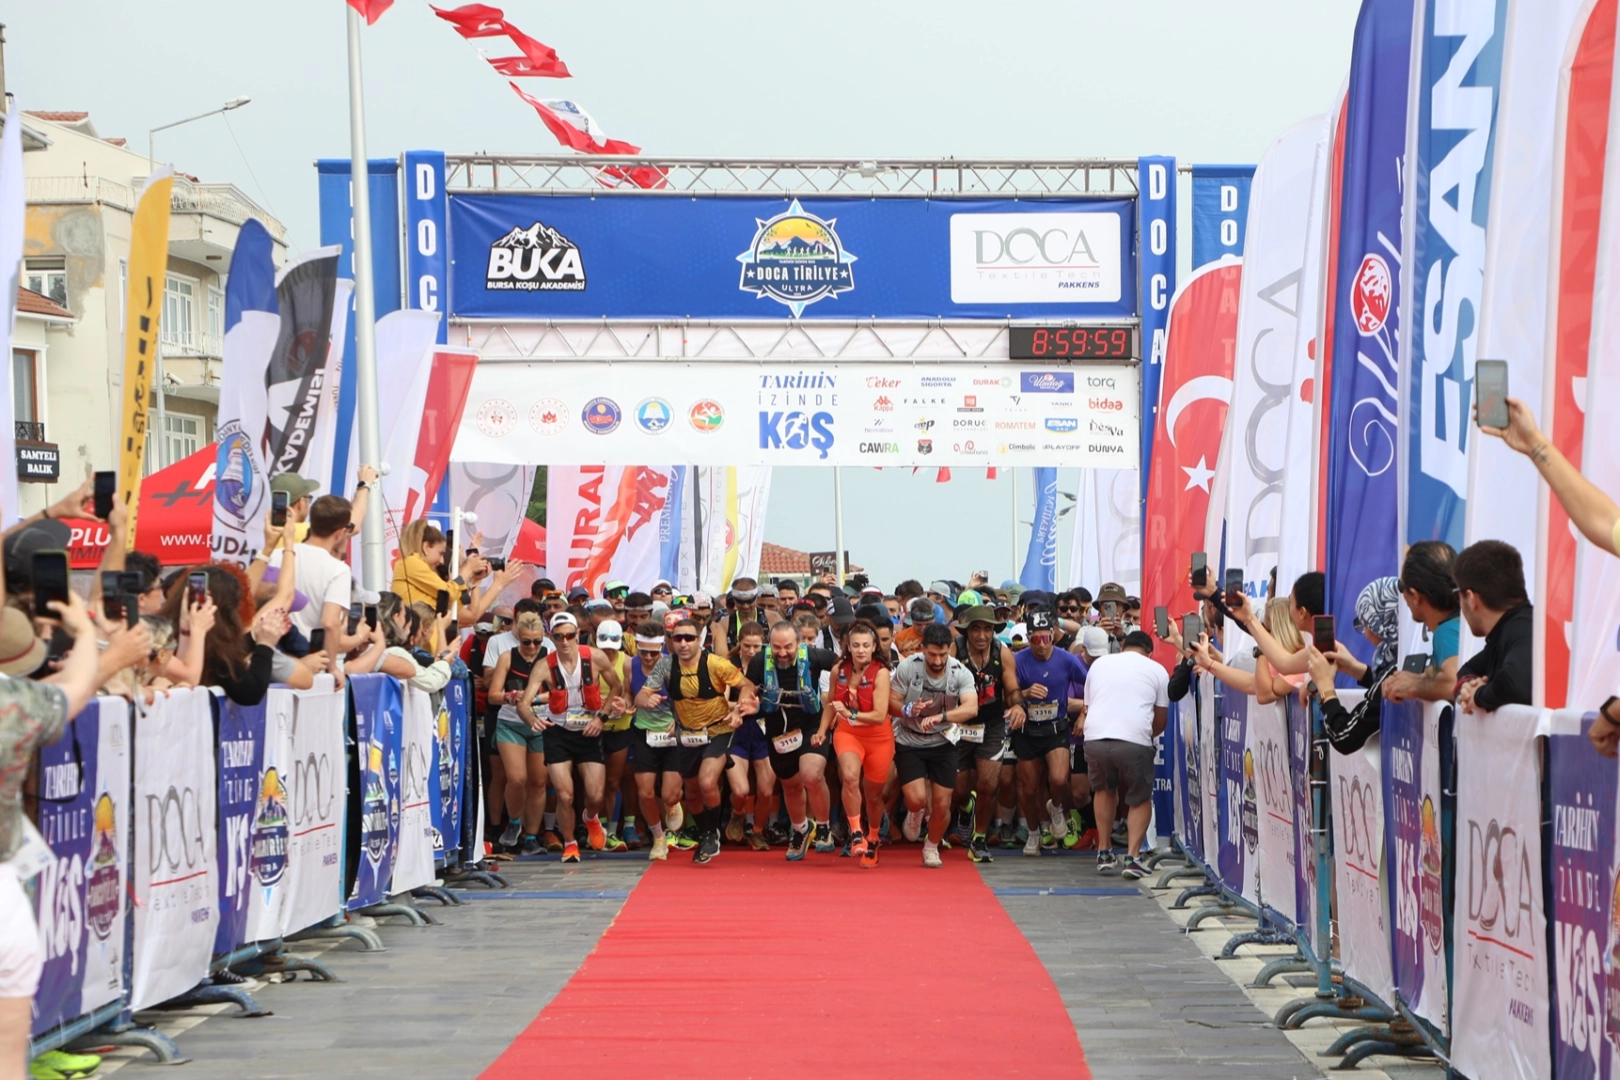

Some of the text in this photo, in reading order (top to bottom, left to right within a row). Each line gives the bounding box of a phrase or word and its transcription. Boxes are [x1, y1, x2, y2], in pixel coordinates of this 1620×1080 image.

[971, 226, 1100, 266] DOCA
[487, 248, 585, 280] BUKA
[757, 264, 839, 281] DOCA TİRİLYE
[977, 269, 1101, 280] Textile Tech
[487, 280, 585, 291] BURSA KOŞU AKADEMİSİ
[781, 283, 814, 292] ULTRA
[1058, 281, 1101, 289] PAKKENS
[1031, 329, 1128, 356] 8:59:59
[759, 370, 837, 389] TARİHİN
[972, 378, 1001, 386] DURAK
[758, 390, 838, 406] İZİNDE
[873, 404, 895, 412] Kappa
[994, 421, 1037, 430] ROMATEM
[759, 411, 835, 459] KOŞ
[859, 442, 900, 454] CAWRA
[27, 463, 53, 475] BALIK
[780, 736, 798, 748] 3114
